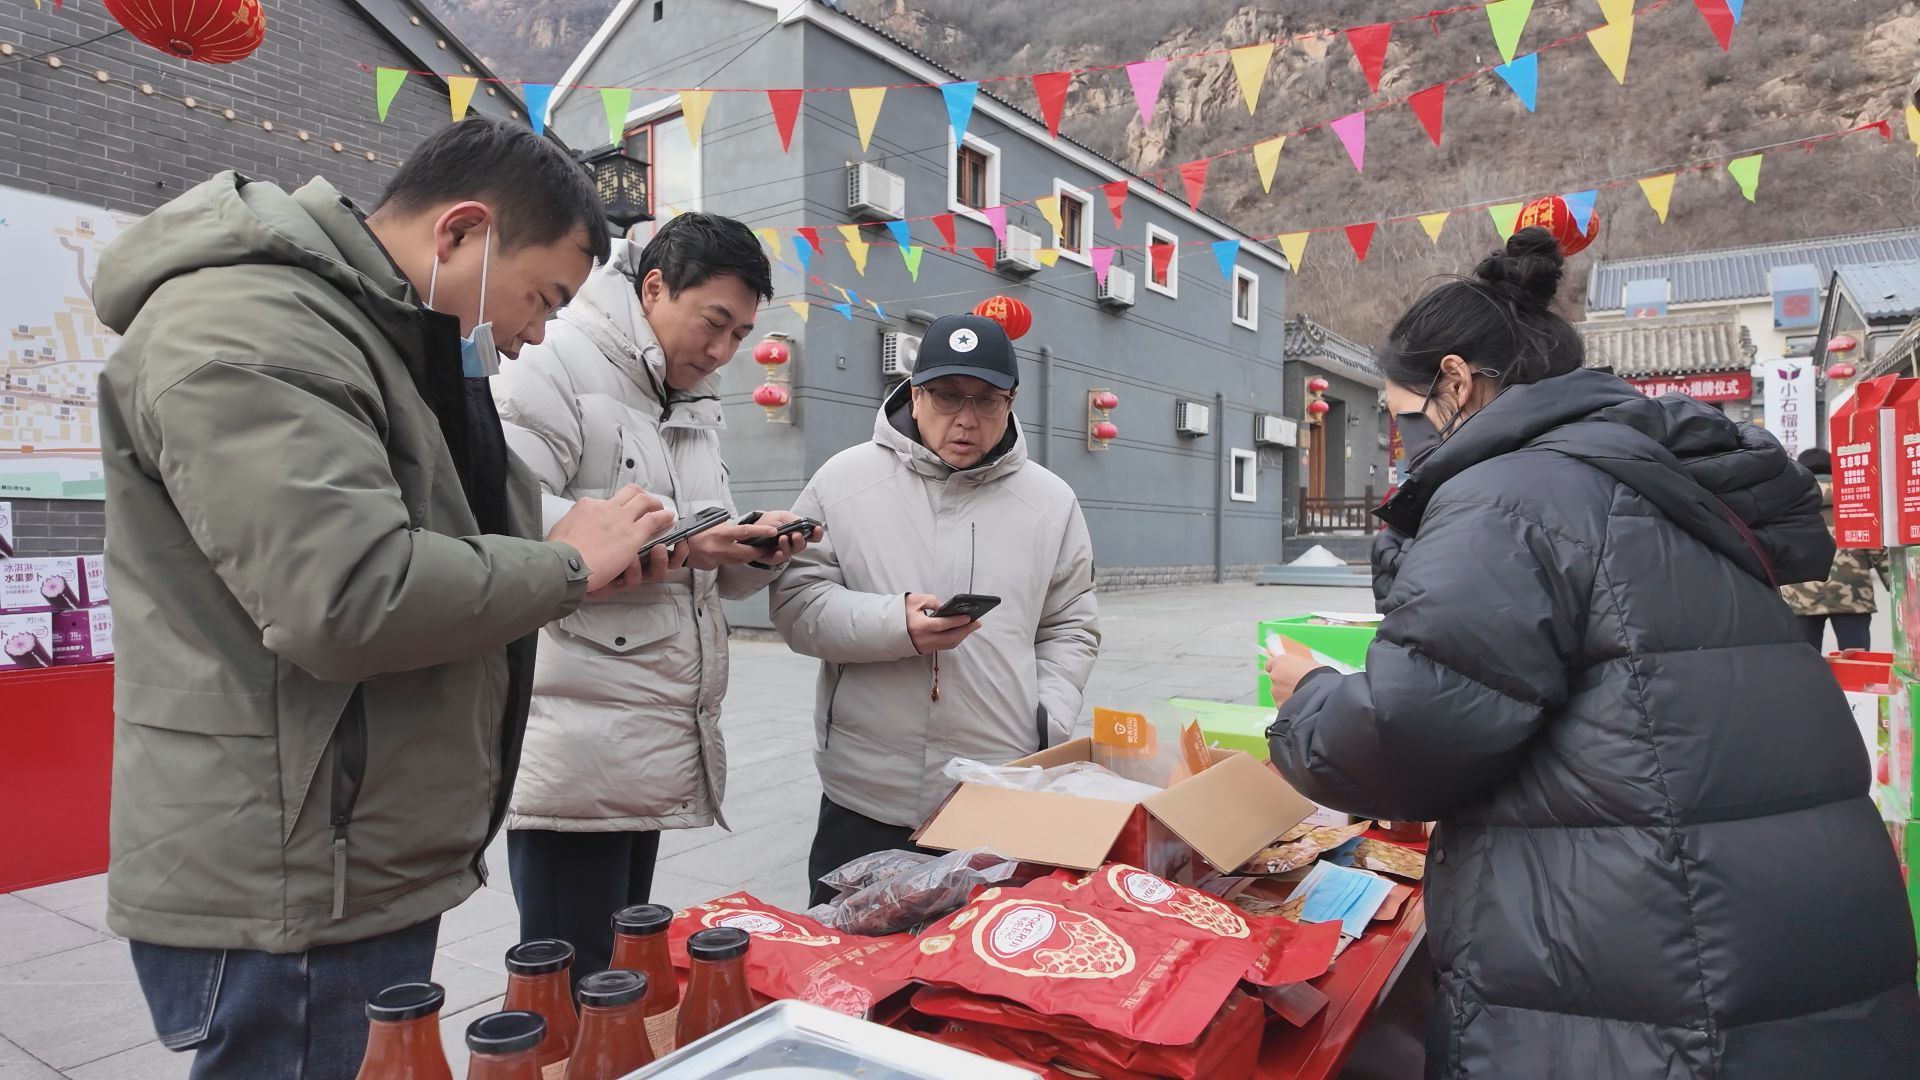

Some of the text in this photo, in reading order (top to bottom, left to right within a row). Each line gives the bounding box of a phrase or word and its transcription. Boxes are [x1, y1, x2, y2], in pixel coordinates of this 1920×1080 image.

[4, 563, 33, 572] 冰淇淋
[4, 573, 43, 583] 水果萝卜
